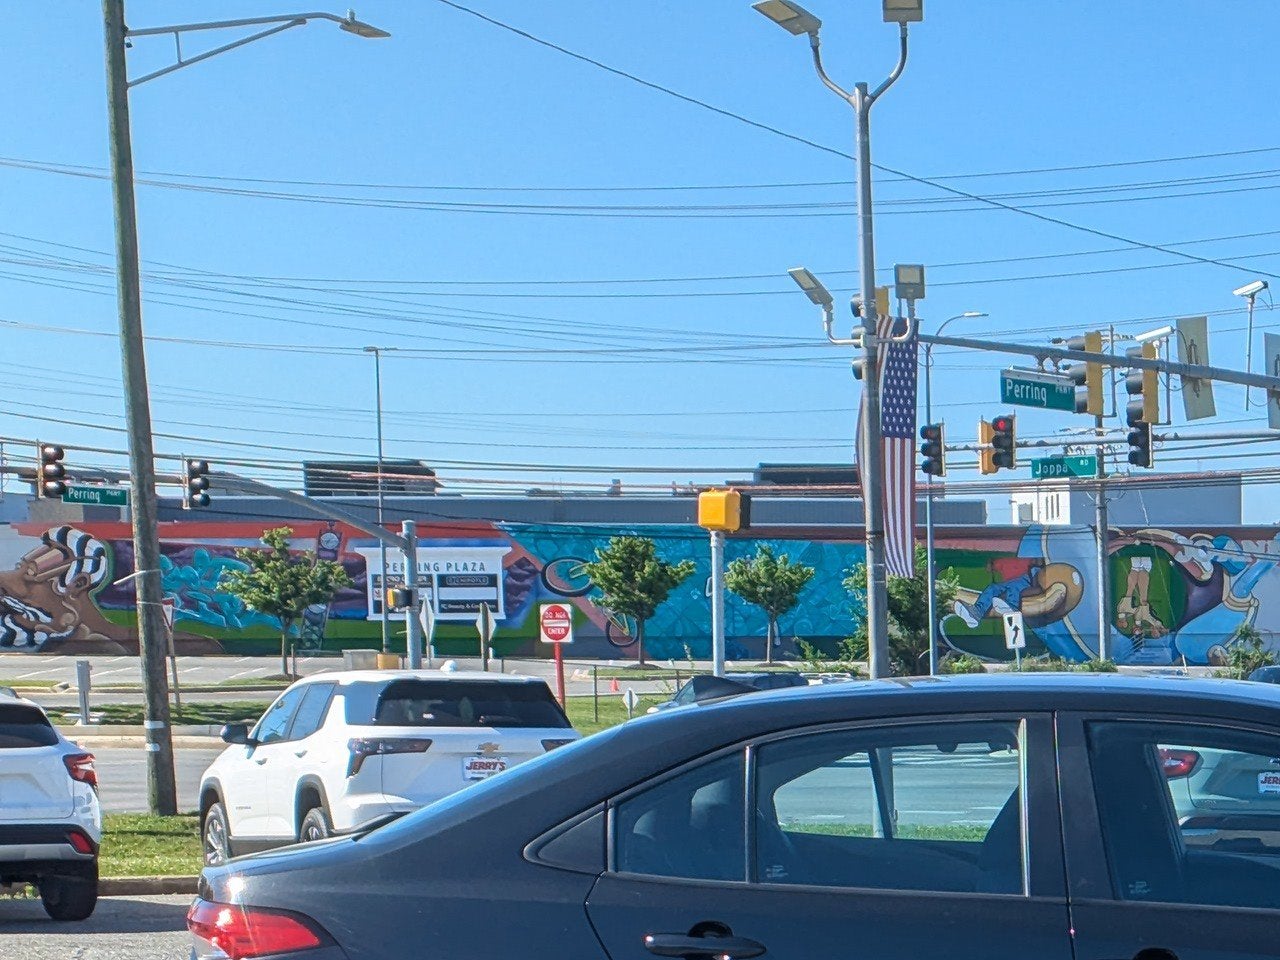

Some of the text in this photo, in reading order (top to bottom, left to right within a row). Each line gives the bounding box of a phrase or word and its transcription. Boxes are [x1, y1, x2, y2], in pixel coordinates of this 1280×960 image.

[1006, 379, 1047, 406] Perring
[1035, 462, 1068, 475] Joppa
[68, 487, 101, 503] Perring
[446, 561, 486, 572] PLAZA
[465, 761, 506, 772] JERRY'S
